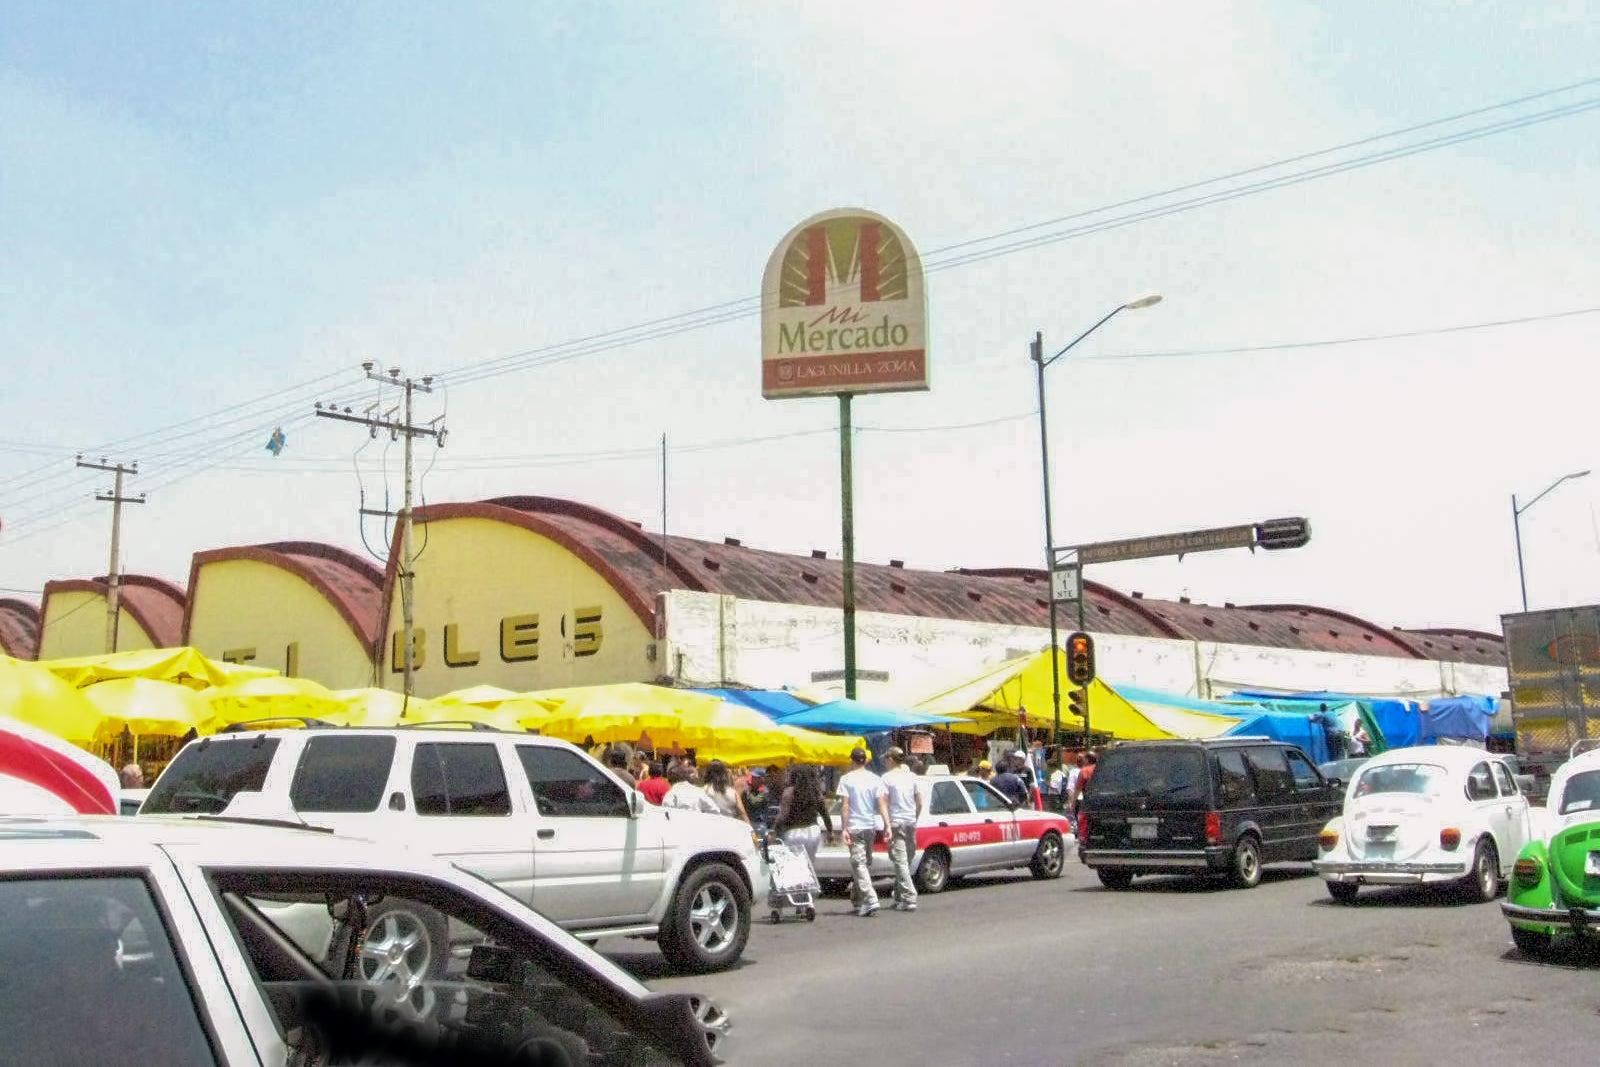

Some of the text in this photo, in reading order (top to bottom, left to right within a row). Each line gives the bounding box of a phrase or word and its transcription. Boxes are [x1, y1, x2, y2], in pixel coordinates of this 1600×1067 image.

[809, 305, 871, 328] Mi
[777, 315, 909, 354] Mercado
[796, 360, 917, 378] LAGUNILLA ZONA
